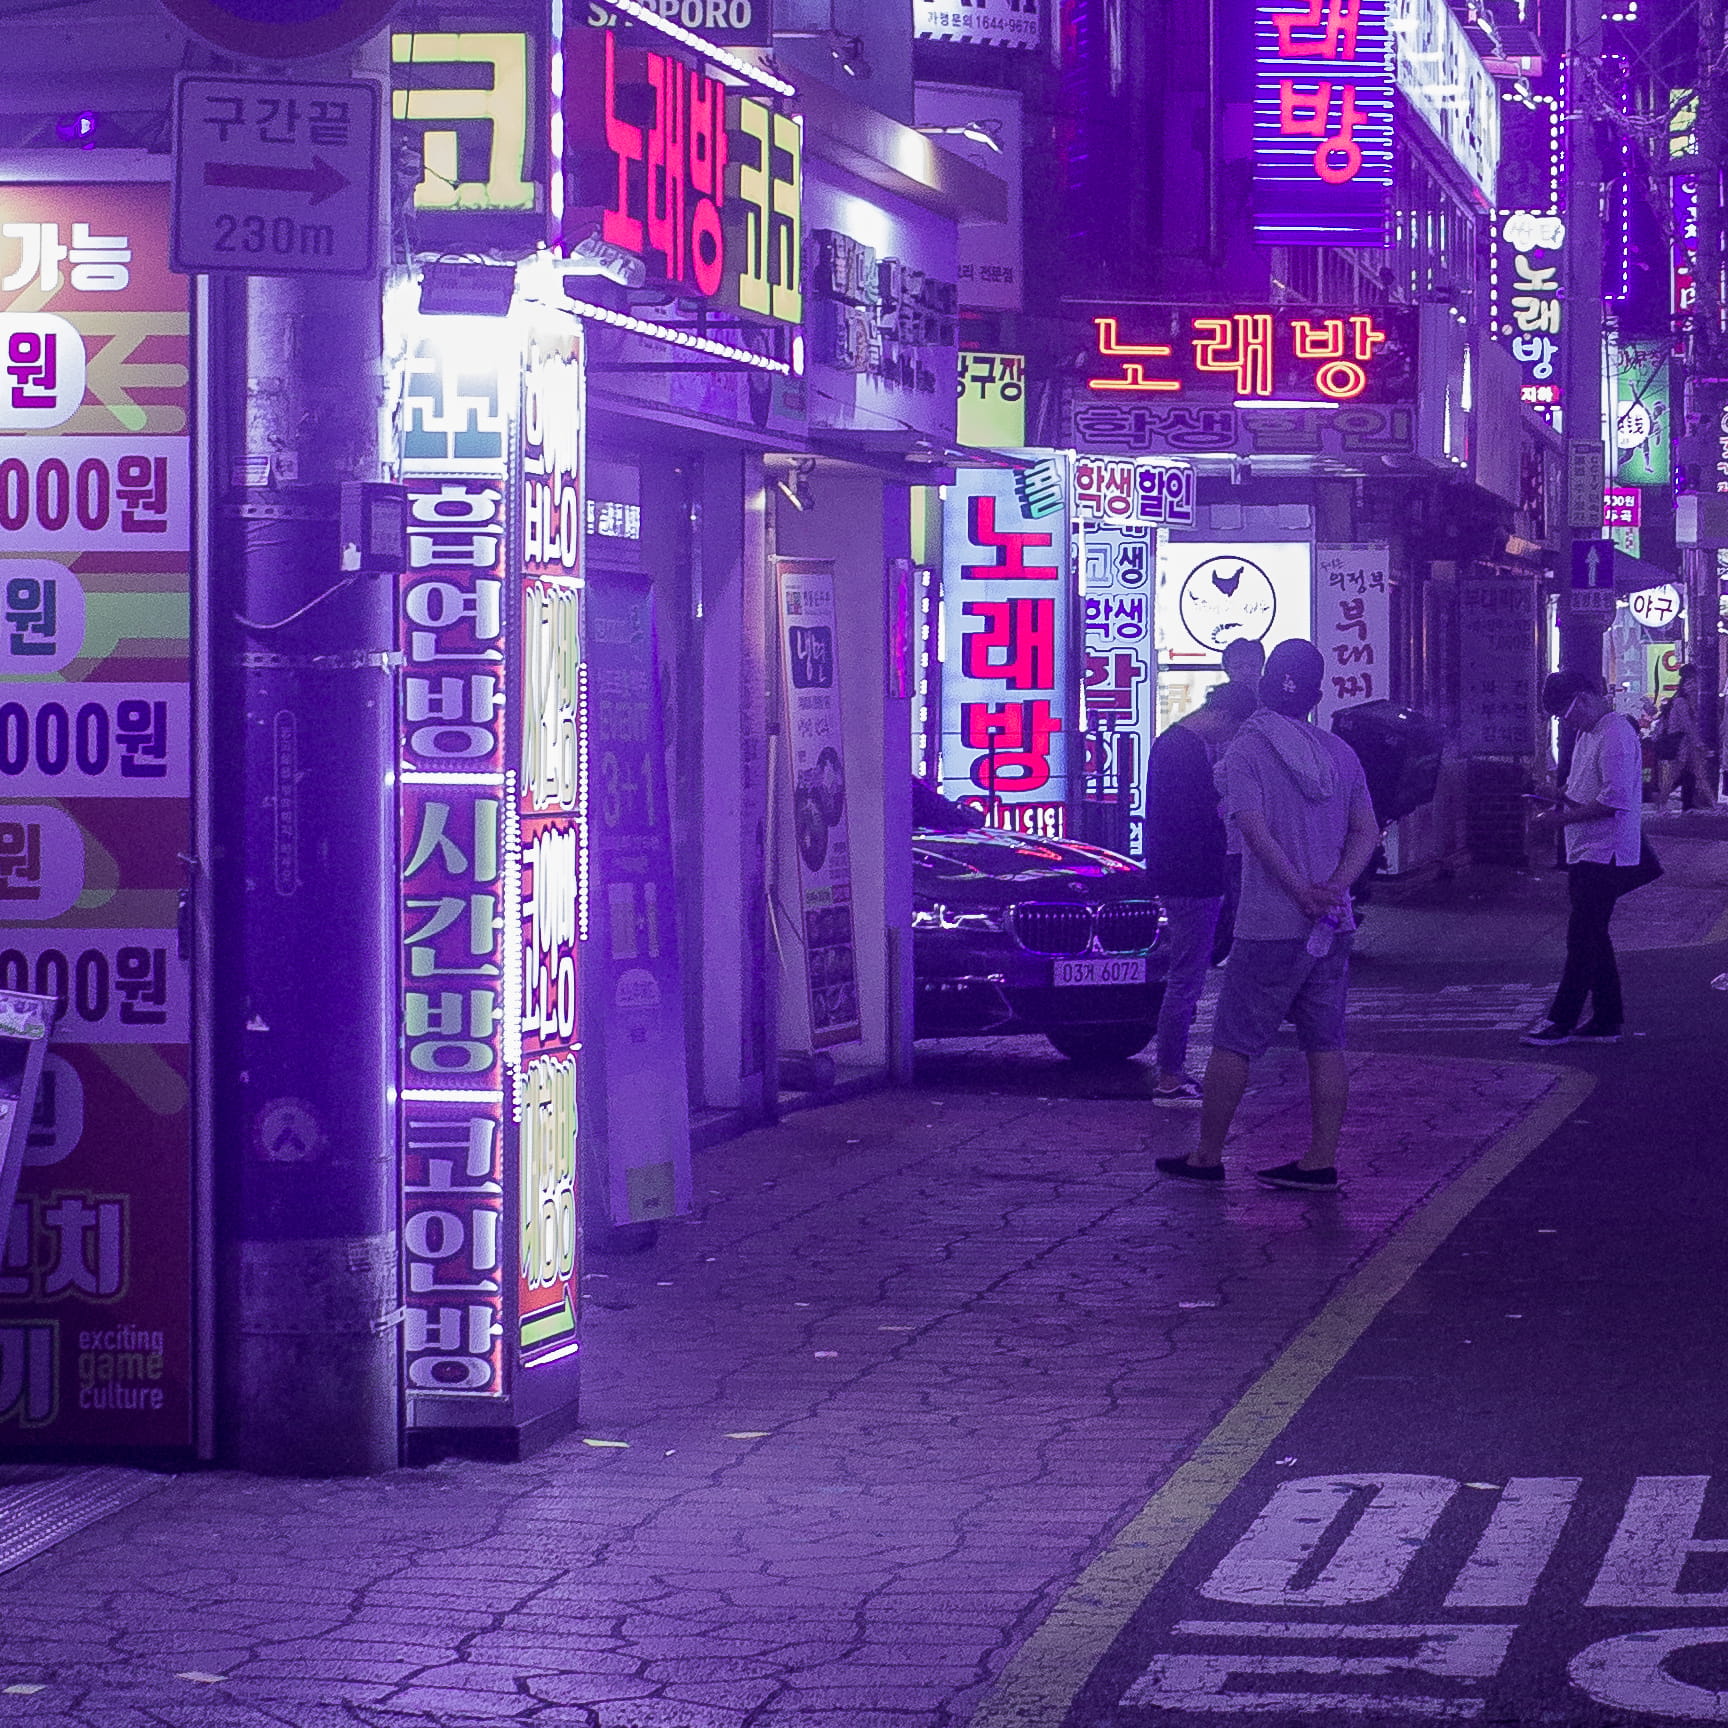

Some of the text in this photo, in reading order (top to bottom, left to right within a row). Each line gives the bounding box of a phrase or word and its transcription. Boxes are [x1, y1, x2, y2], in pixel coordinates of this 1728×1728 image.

[203, 95, 350, 147] 구간끝
[603, 29, 729, 298] 노래방
[2, 222, 132, 292] 가능
[213, 213, 335, 258] 230m
[1510, 253, 1561, 379] 노래방
[7, 330, 58, 410] 원
[1088, 314, 1386, 399] 노래방
[1075, 406, 1239, 451] 학생
[1076, 463, 1192, 520] 학생 할인
[1328, 569, 1386, 594] 의정부
[1632, 594, 1674, 623] 야구
[6, 576, 58, 658] 원
[405, 483, 503, 760] 흡연방
[961, 495, 1062, 792] 노래방
[403, 798, 504, 1074] 시간방
[1101, 961, 1140, 981] 6072
[403, 1116, 504, 1390] 코인방
[78, 1324, 165, 1360] exciting
[78, 1353, 165, 1389] game
[78, 1382, 165, 1412] culture
